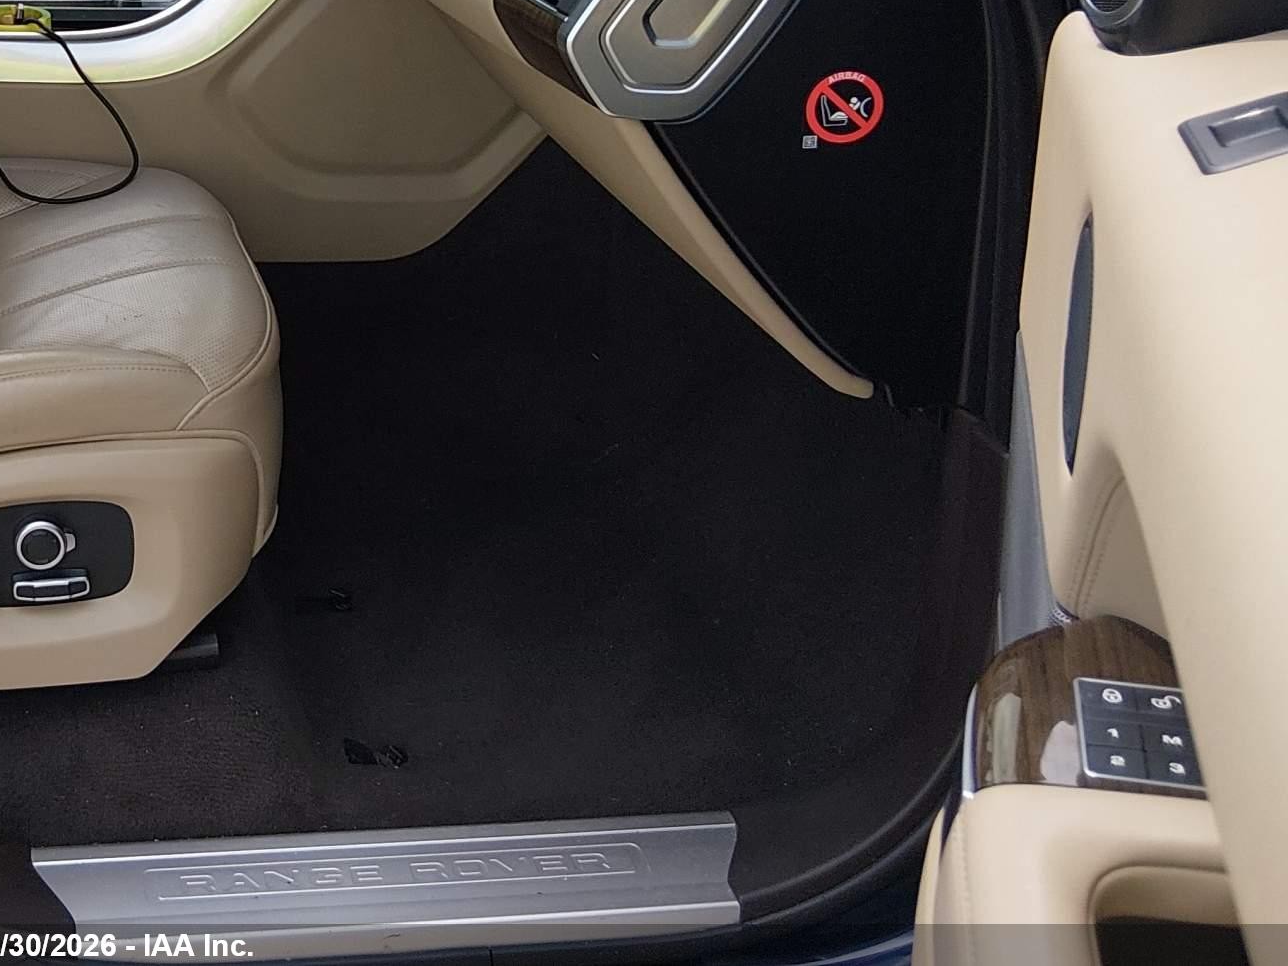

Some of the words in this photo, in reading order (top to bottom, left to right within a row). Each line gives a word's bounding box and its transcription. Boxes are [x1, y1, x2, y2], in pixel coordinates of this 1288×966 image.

[827, 71, 867, 85] AIRBAG
[1107, 728, 1119, 739] 1
[179, 864, 384, 891] RANGE
[409, 852, 611, 880] ROVER
